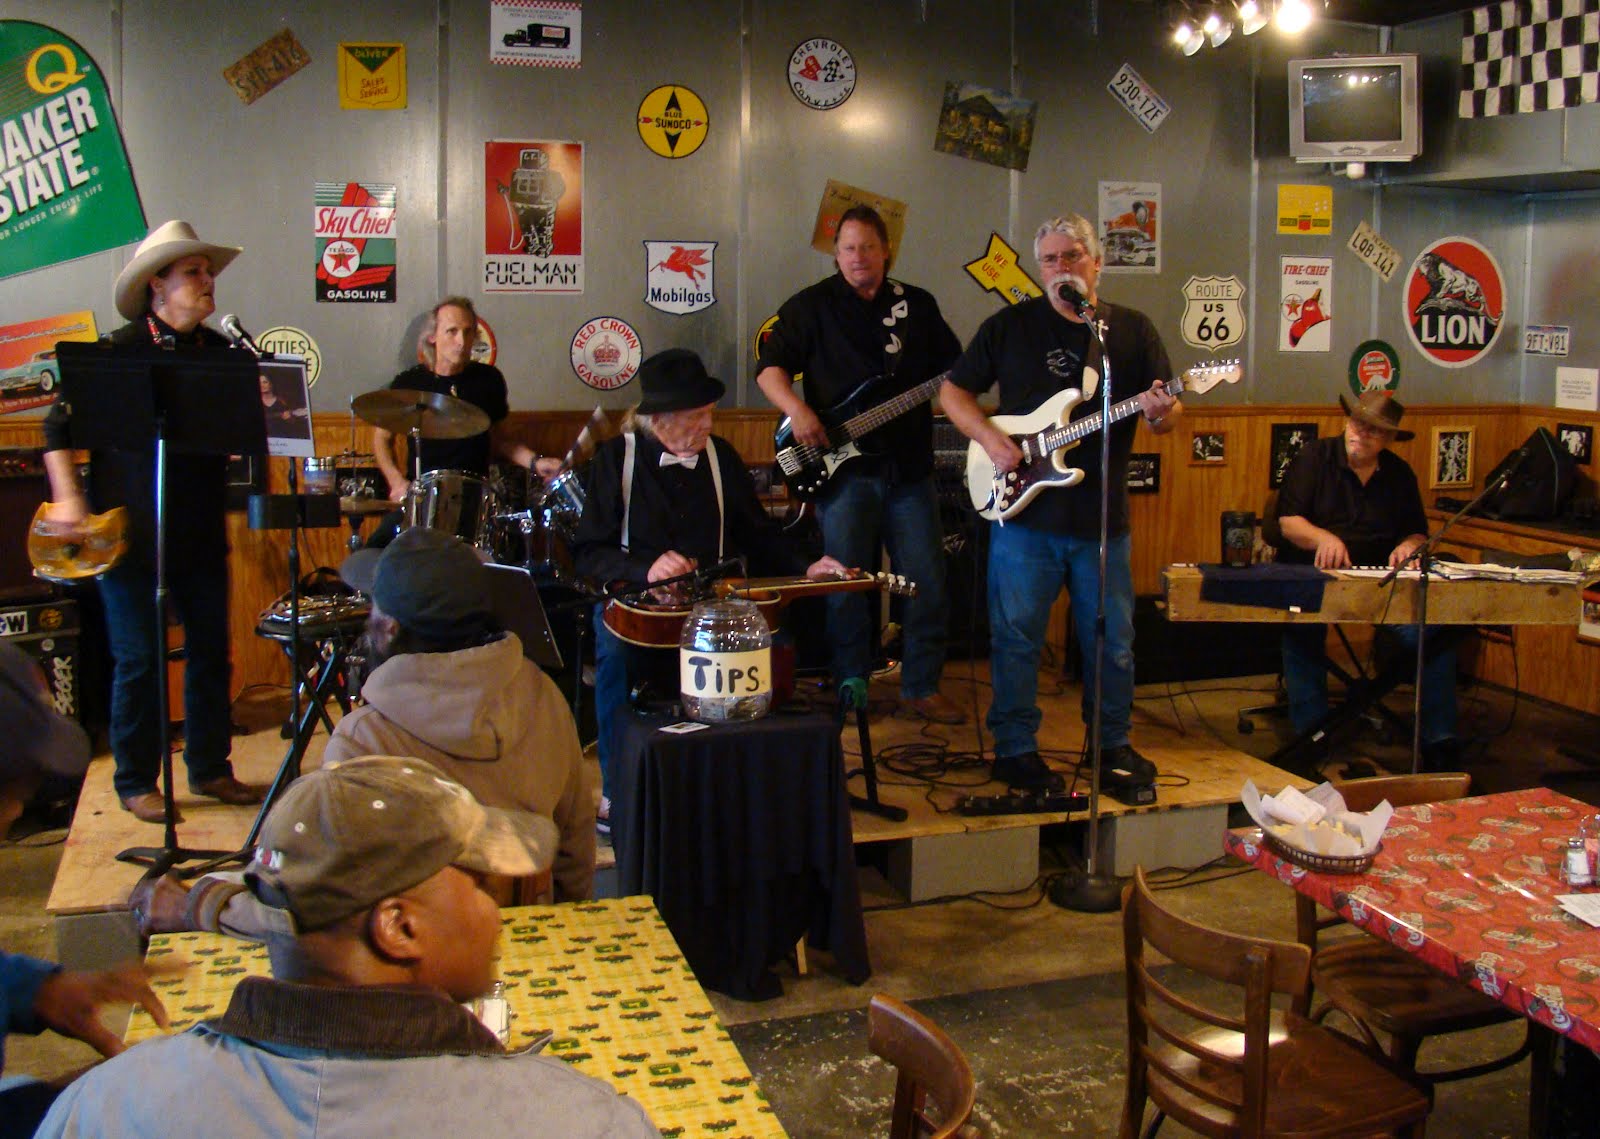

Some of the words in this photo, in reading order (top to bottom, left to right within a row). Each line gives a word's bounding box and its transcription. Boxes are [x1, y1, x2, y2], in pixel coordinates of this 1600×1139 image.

[793, 40, 853, 70] CHEVROLET
[359, 85, 388, 99] SERVICE
[361, 77, 384, 88] SALES
[0, 87, 99, 171] AKER
[655, 117, 691, 130] SUNOCO
[13, 211, 47, 232] LONGER
[50, 194, 81, 215] ENGINE
[84, 183, 103, 198] LIFE
[316, 207, 349, 239] Sky
[349, 207, 396, 235] Chief
[993, 250, 1009, 270] WE
[1283, 264, 1330, 276] FIRE-CHIEF
[485, 261, 576, 285] FUELMAN
[981, 262, 1001, 282] USE
[326, 289, 387, 299] GASOLINE
[650, 287, 711, 307] Mobilgas
[1195, 284, 1232, 297] ROUTE
[1204, 303, 1224, 312] US
[574, 324, 596, 349] RED
[600, 319, 639, 350] CROWN
[1197, 316, 1230, 341] 66
[1421, 315, 1485, 344] LION
[264, 340, 306, 355] CITIES
[577, 363, 637, 388] GASOLINE
[1519, 806, 1572, 815] Coca-Cola
[1407, 853, 1466, 863] Coca-Cola
